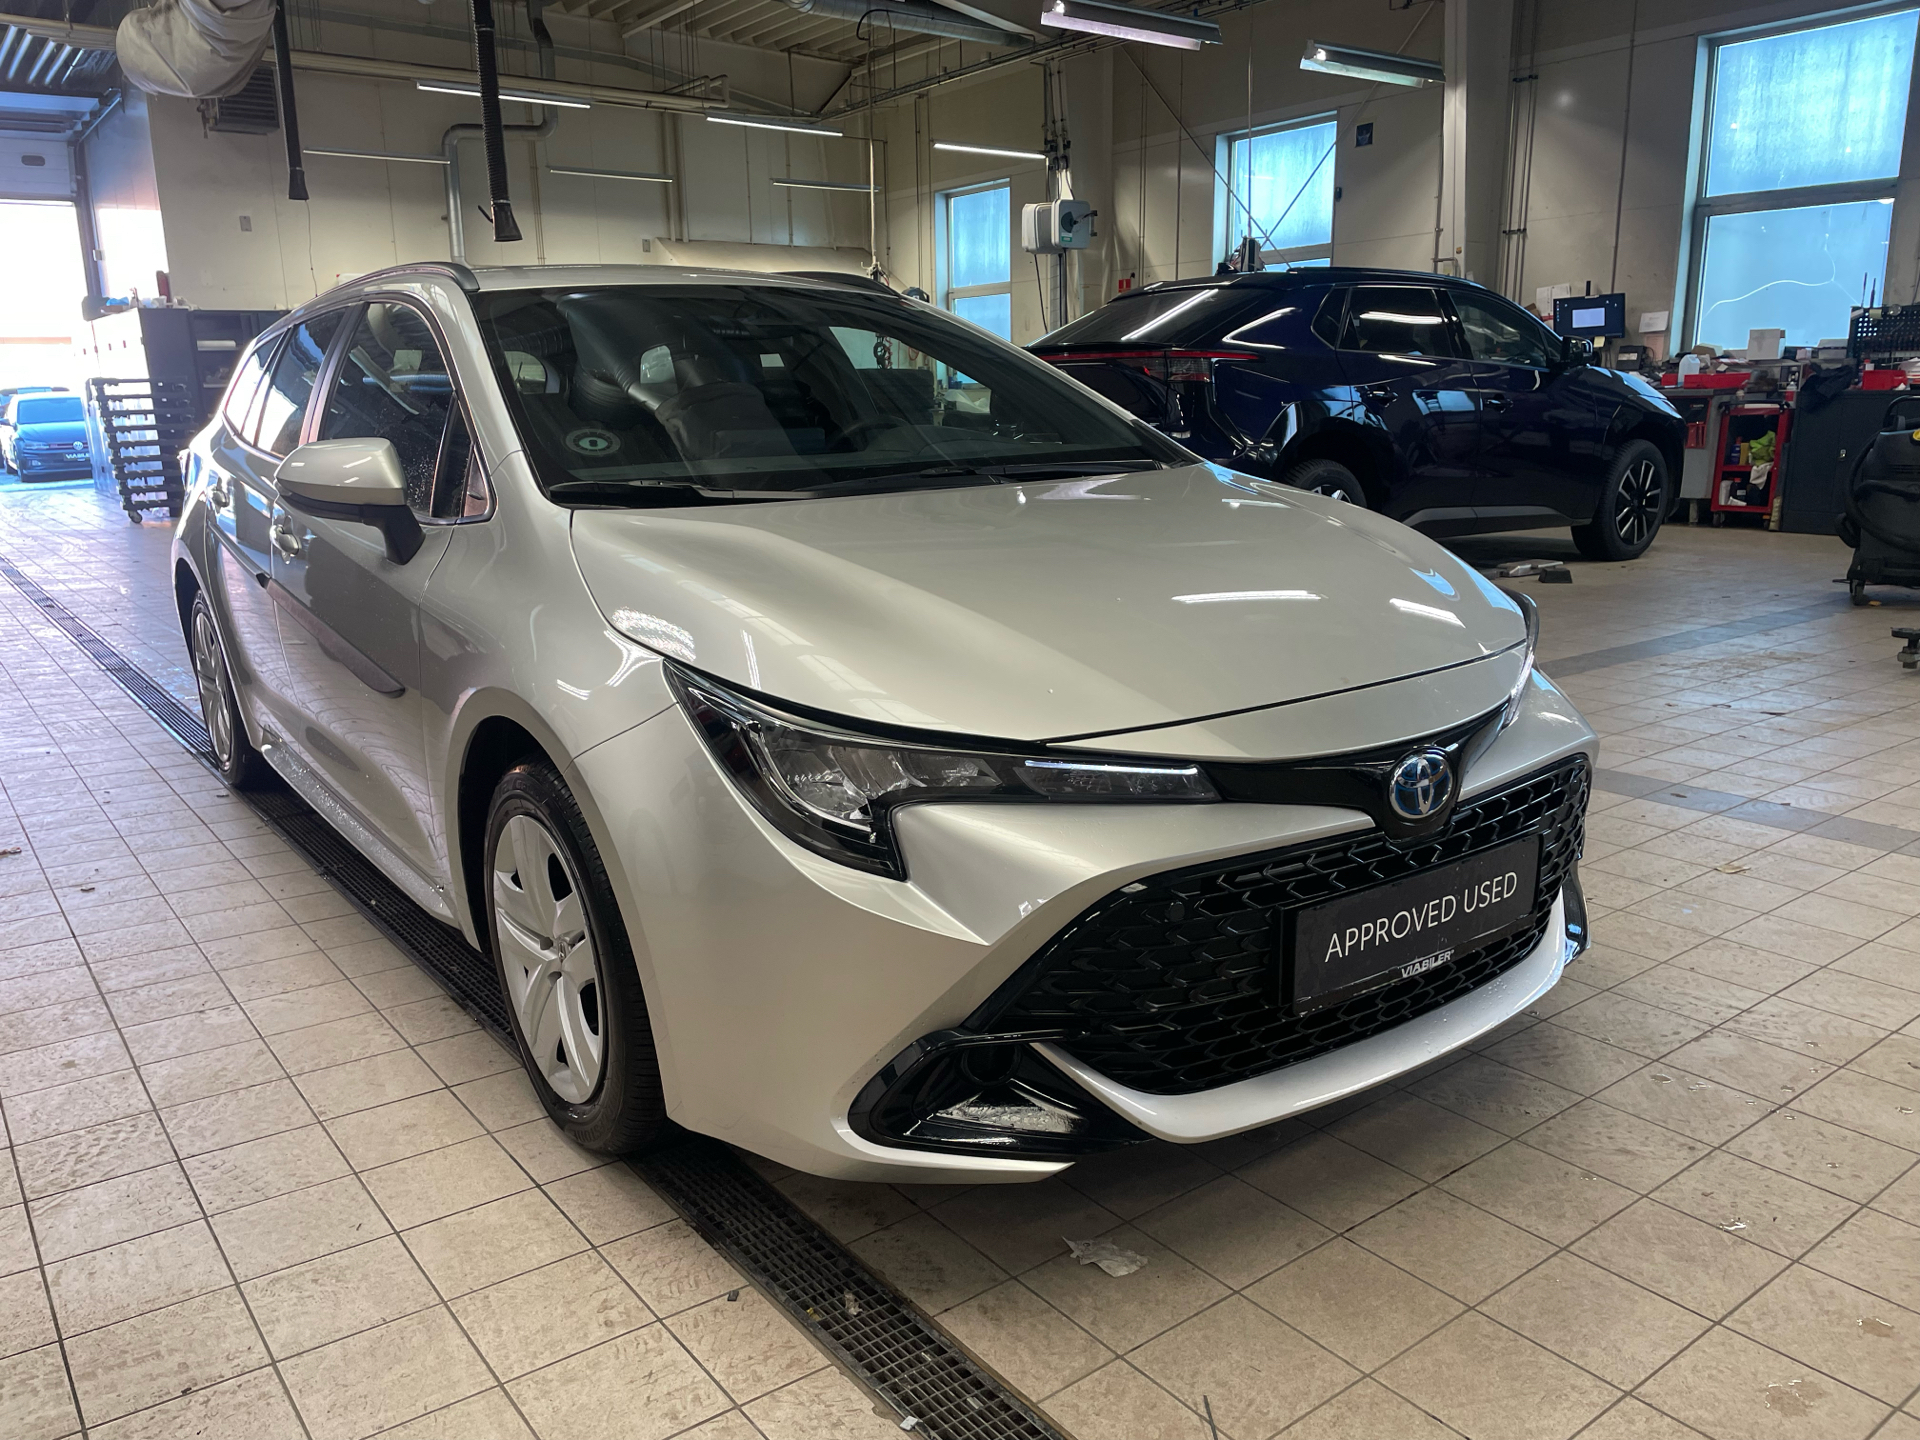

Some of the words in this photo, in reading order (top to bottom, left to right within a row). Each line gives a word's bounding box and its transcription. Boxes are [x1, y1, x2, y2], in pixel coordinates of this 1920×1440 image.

[1324, 895, 1457, 963] APPROVED
[1463, 871, 1518, 914] USED
[1401, 952, 1452, 978] VIABILER
